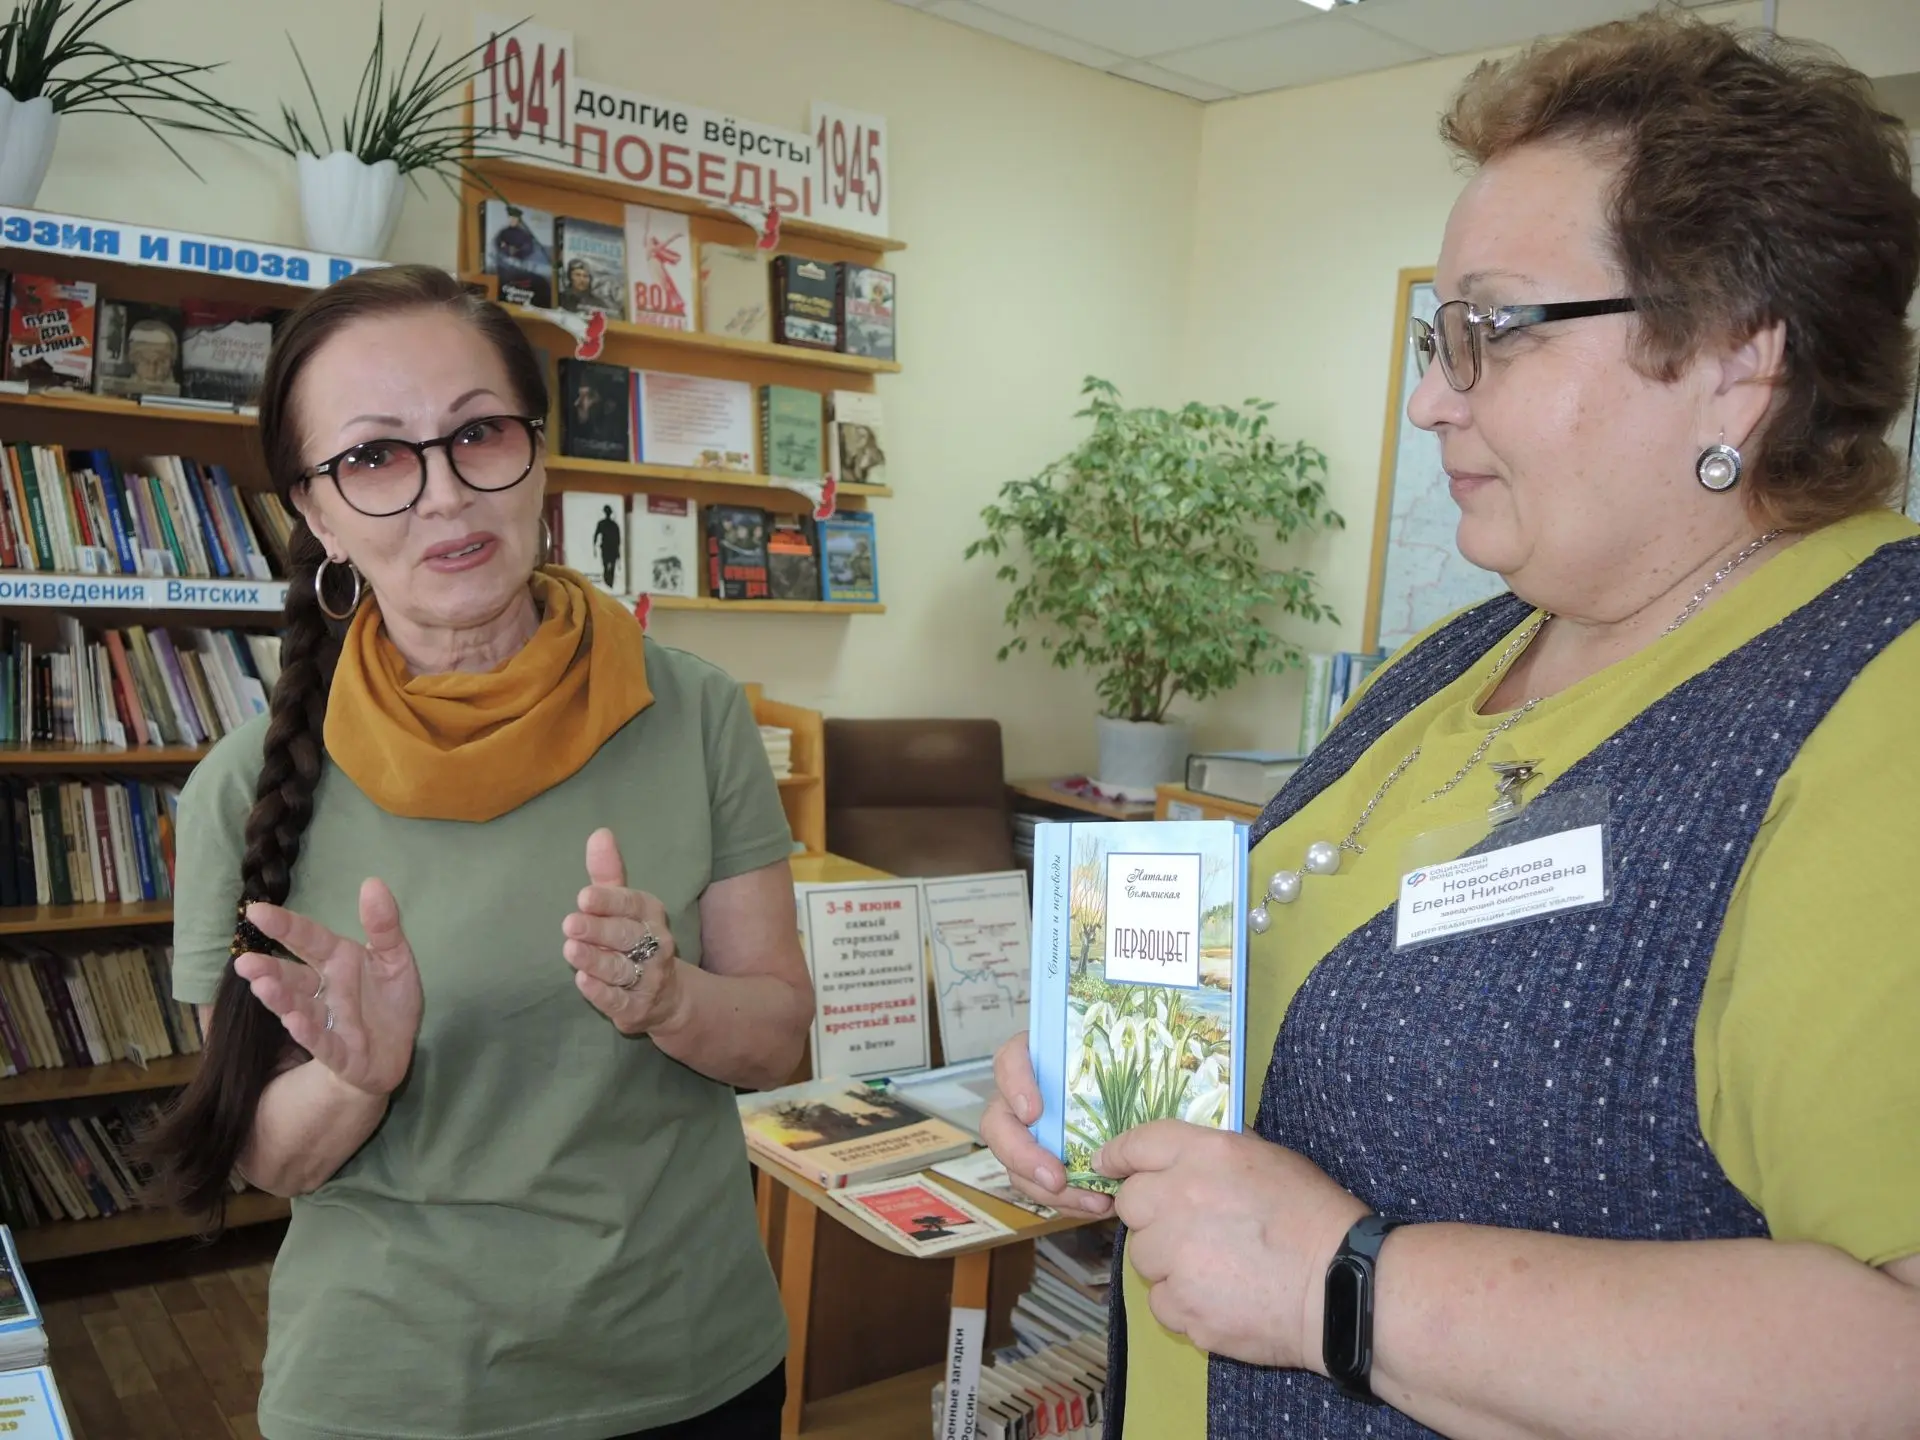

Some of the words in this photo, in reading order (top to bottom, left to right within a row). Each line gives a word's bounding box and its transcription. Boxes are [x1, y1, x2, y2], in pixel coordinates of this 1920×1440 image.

[483, 32, 567, 149] 1941
[574, 88, 689, 134] долгие
[703, 117, 811, 165] вёрсты
[573, 123, 812, 217] ПОБЕДЫ
[815, 115, 882, 217] 1945
[0, 216, 121, 256] эзия
[139, 233, 169, 262] и
[179, 240, 310, 282] проза
[25, 310, 67, 327] ПУЛЯ
[41, 324, 70, 340] ДЛЯ
[19, 336, 86, 358] СТАЛИНА
[167, 582, 259, 604] Вятских
[1127, 868, 1178, 883] Наталия
[1429, 856, 1488, 876] СОЦИАЛЬНЫЙ
[1429, 870, 1454, 881] ФОНД
[1443, 857, 1554, 893] Новосёлова
[1412, 893, 1465, 914] Елена
[1471, 864, 1587, 900] Николаевна
[1496, 886, 1555, 905] библиотекой
[858, 899, 903, 913] июня
[845, 917, 886, 930] самый
[1411, 926, 1437, 938] ЦЕНТР
[832, 930, 900, 947] старинный
[1114, 928, 1191, 967] ПЕРВОЦВЕТ
[852, 948, 894, 960] России
[1048, 927, 1059, 979] Стихи
[832, 967, 866, 980] самый
[822, 995, 917, 1016] Великорецкий
[824, 1014, 890, 1035] крестный
[894, 1013, 917, 1025] ход
[951, 1328, 965, 1386] загадки
